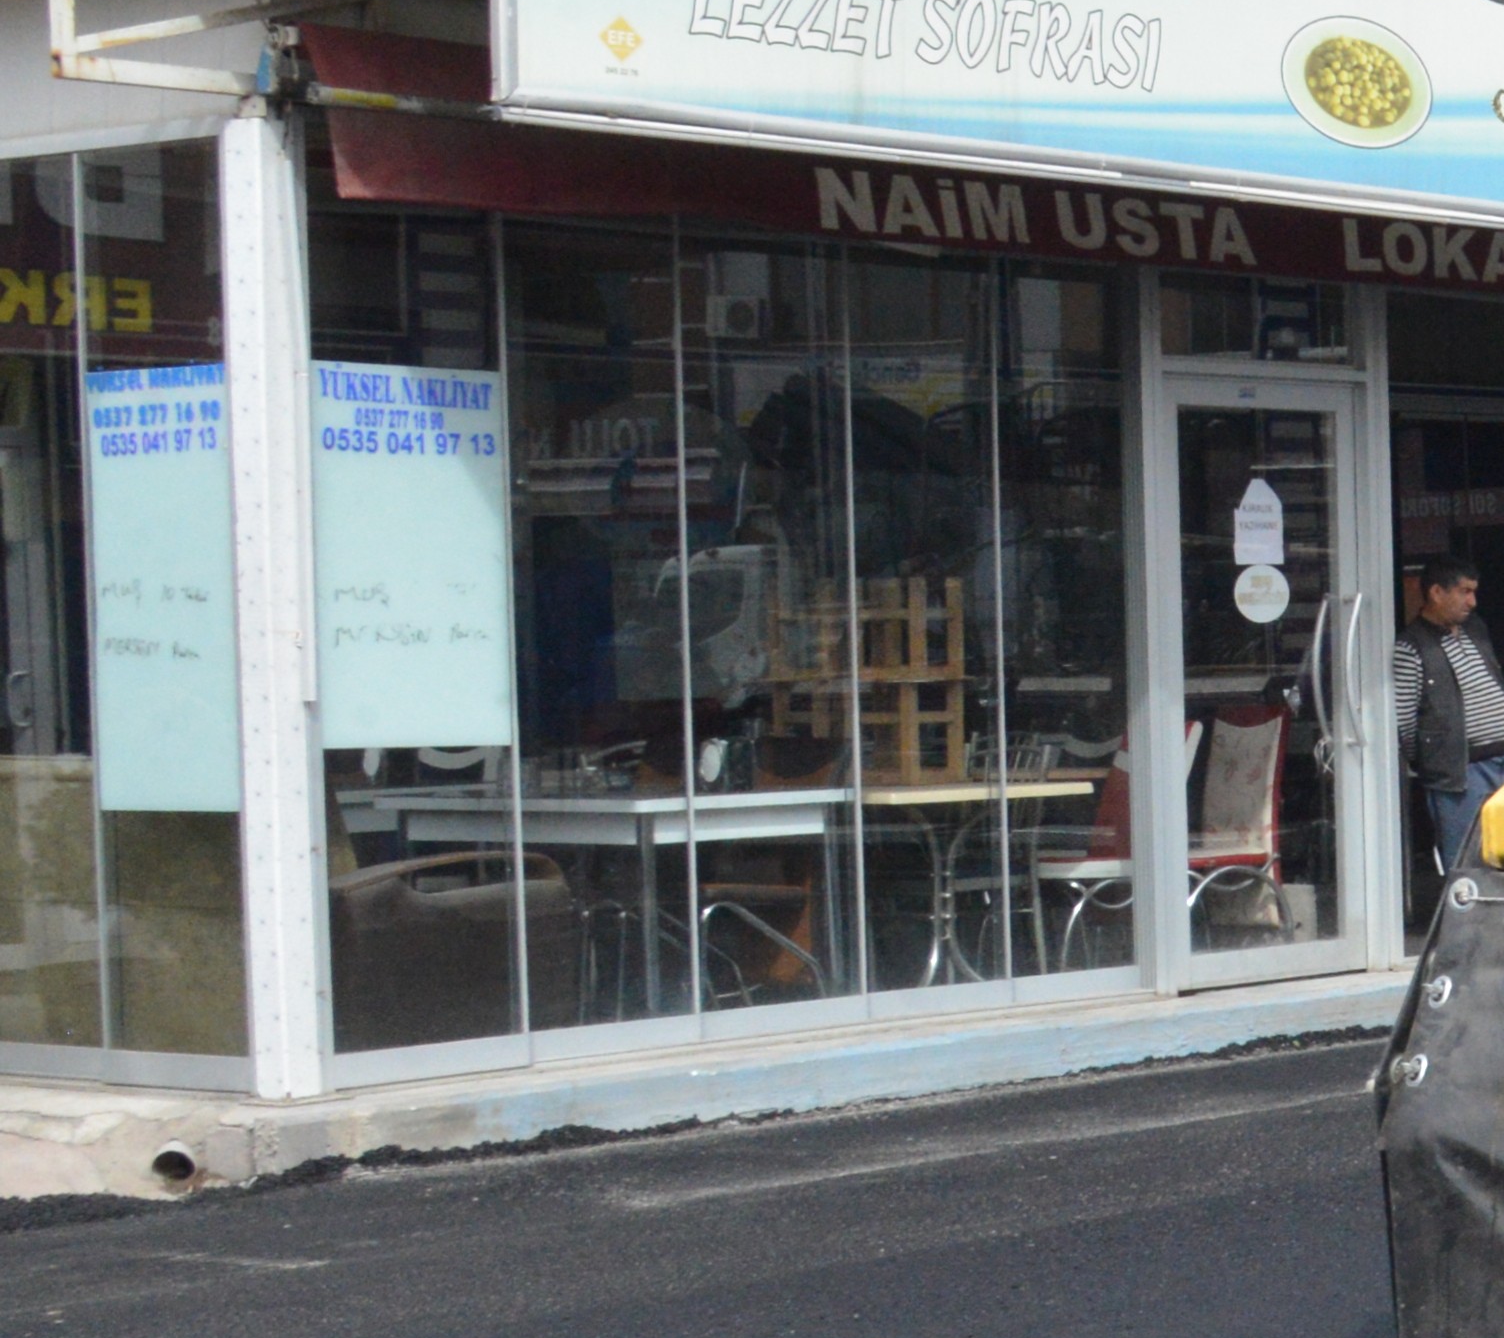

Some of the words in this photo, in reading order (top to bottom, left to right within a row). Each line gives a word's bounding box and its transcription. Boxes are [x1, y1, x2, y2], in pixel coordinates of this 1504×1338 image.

[1055, 190, 1257, 266] USTA
[318, 363, 396, 404] YÜKSEL
[401, 375, 492, 411] NAKLİYAT
[101, 432, 138, 457] 0535
[142, 430, 168, 455] 041
[174, 428, 192, 453] 97
[198, 426, 217, 450] 13
[322, 427, 378, 454] 0535
[387, 432, 426, 455] 041
[435, 433, 461, 456] 97
[470, 434, 496, 456] 13
